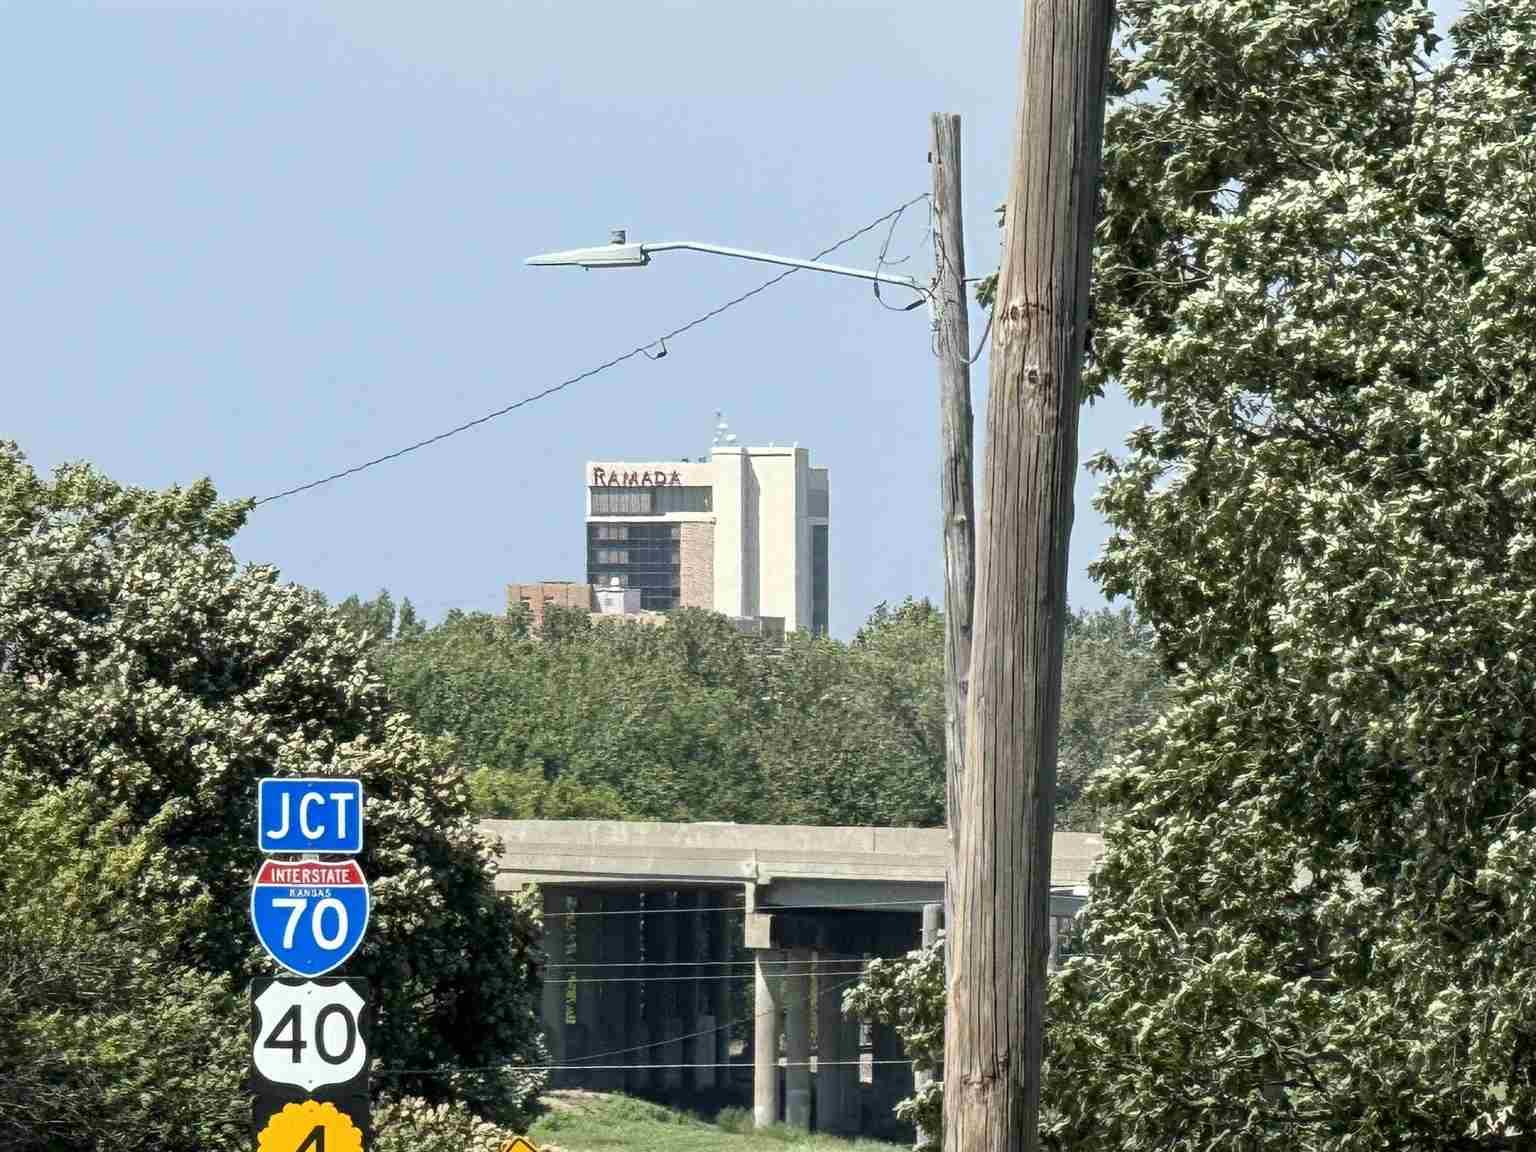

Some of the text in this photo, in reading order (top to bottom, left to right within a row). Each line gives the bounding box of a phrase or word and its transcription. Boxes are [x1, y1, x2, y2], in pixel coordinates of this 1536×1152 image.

[593, 467, 682, 487] RAMADA
[266, 792, 354, 840] JCT
[271, 868, 351, 883] INTERSTATE
[289, 888, 332, 898] KANSAS
[271, 898, 349, 951] 70
[263, 1002, 357, 1065] 40
